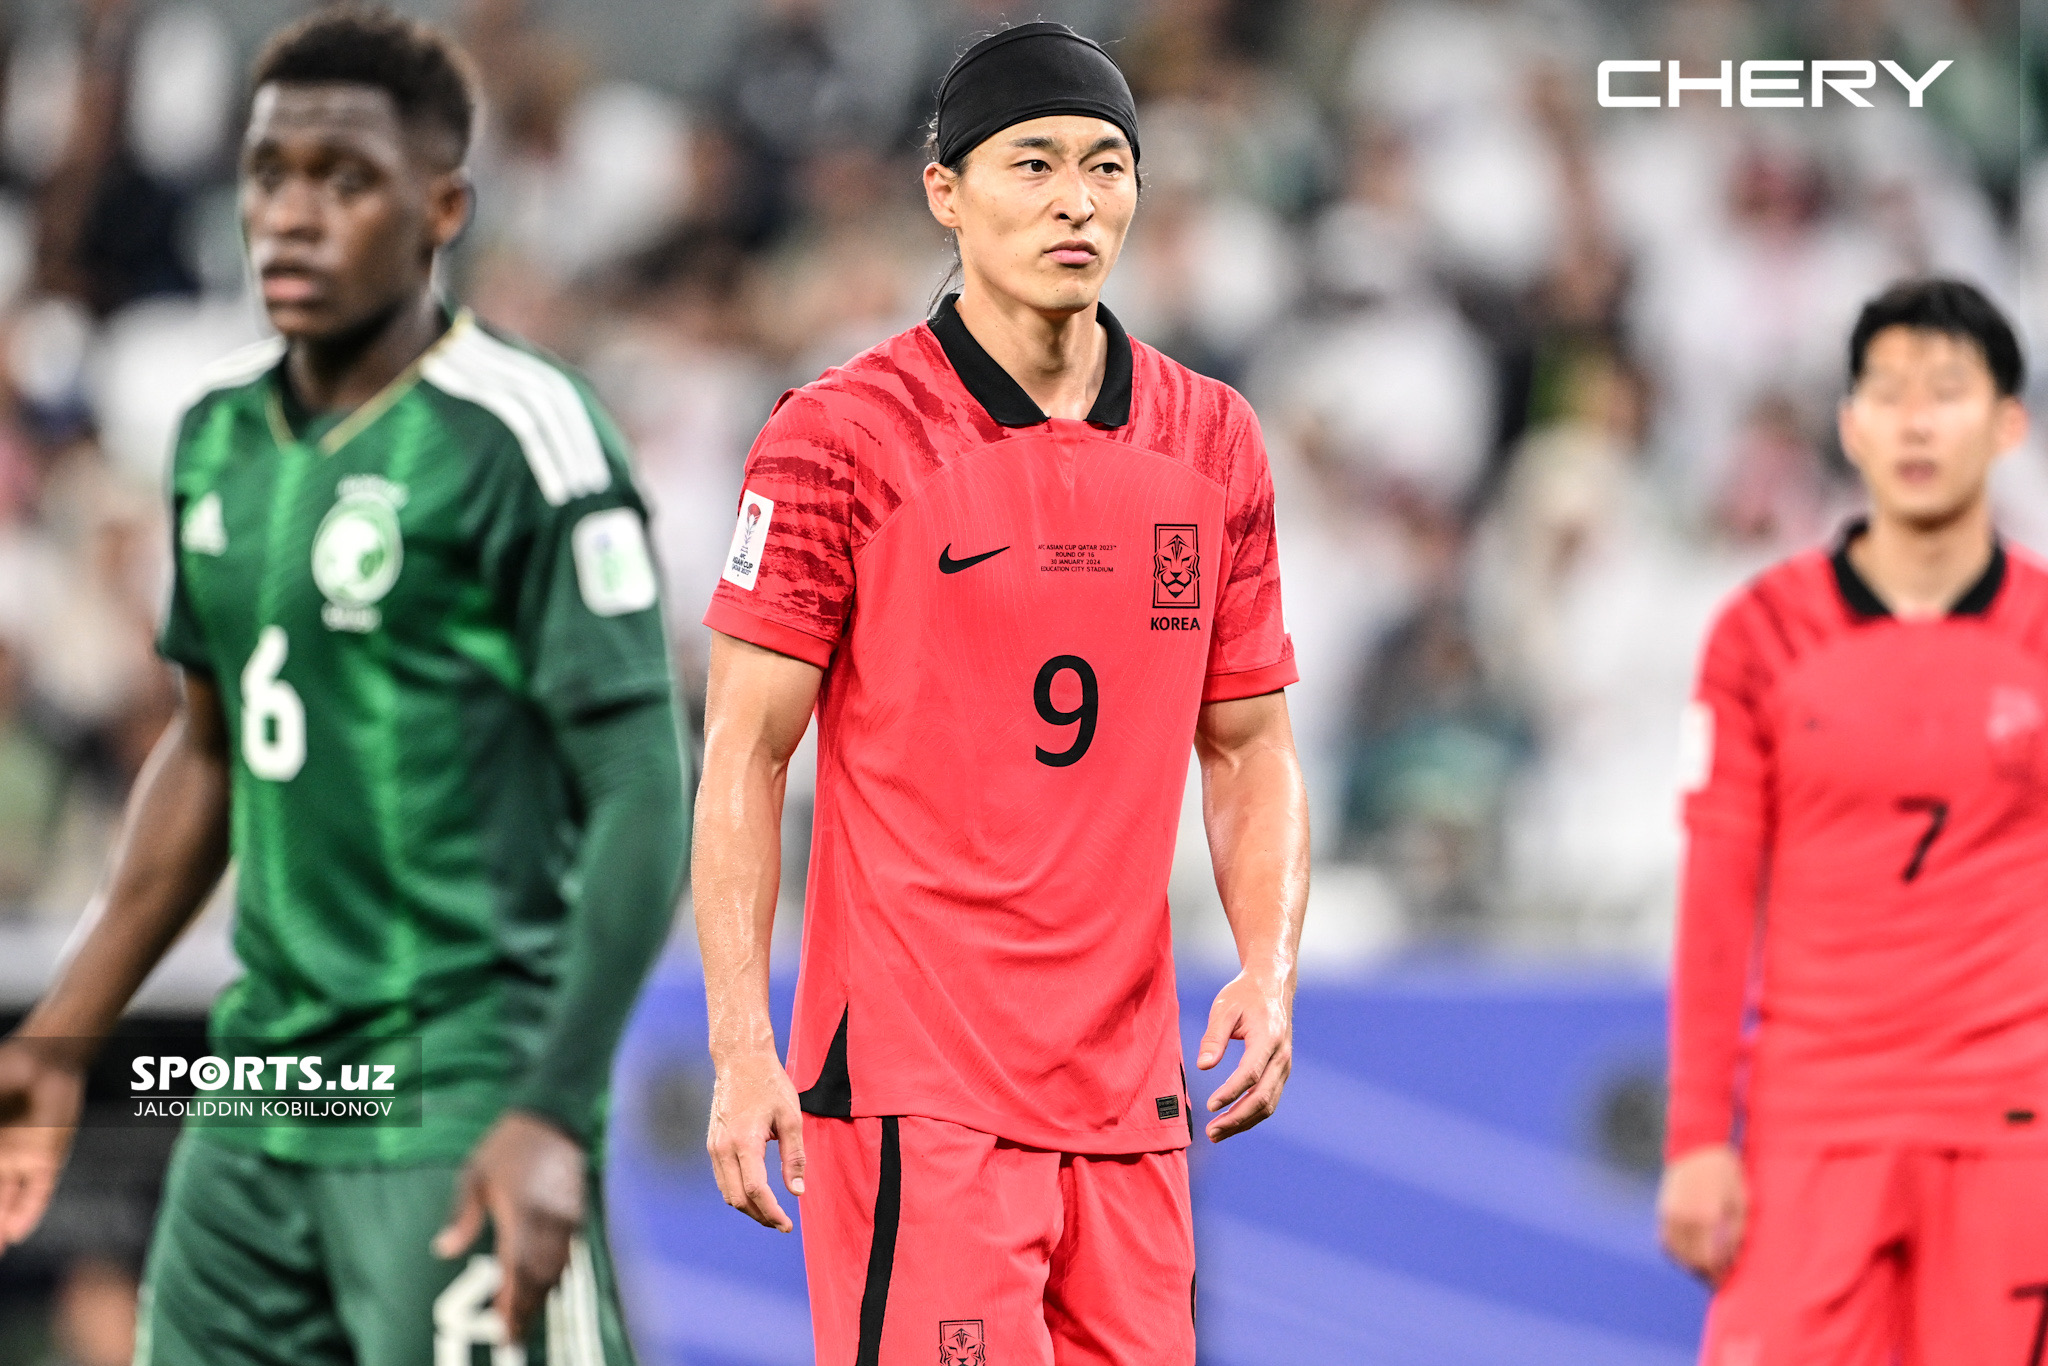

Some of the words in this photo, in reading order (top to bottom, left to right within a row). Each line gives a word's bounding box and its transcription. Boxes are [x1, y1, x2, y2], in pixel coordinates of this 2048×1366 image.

[1151, 616, 1200, 630] KOREA
[240, 624, 307, 783] 6
[1033, 655, 1099, 767] 9
[1895, 796, 1949, 883] 7
